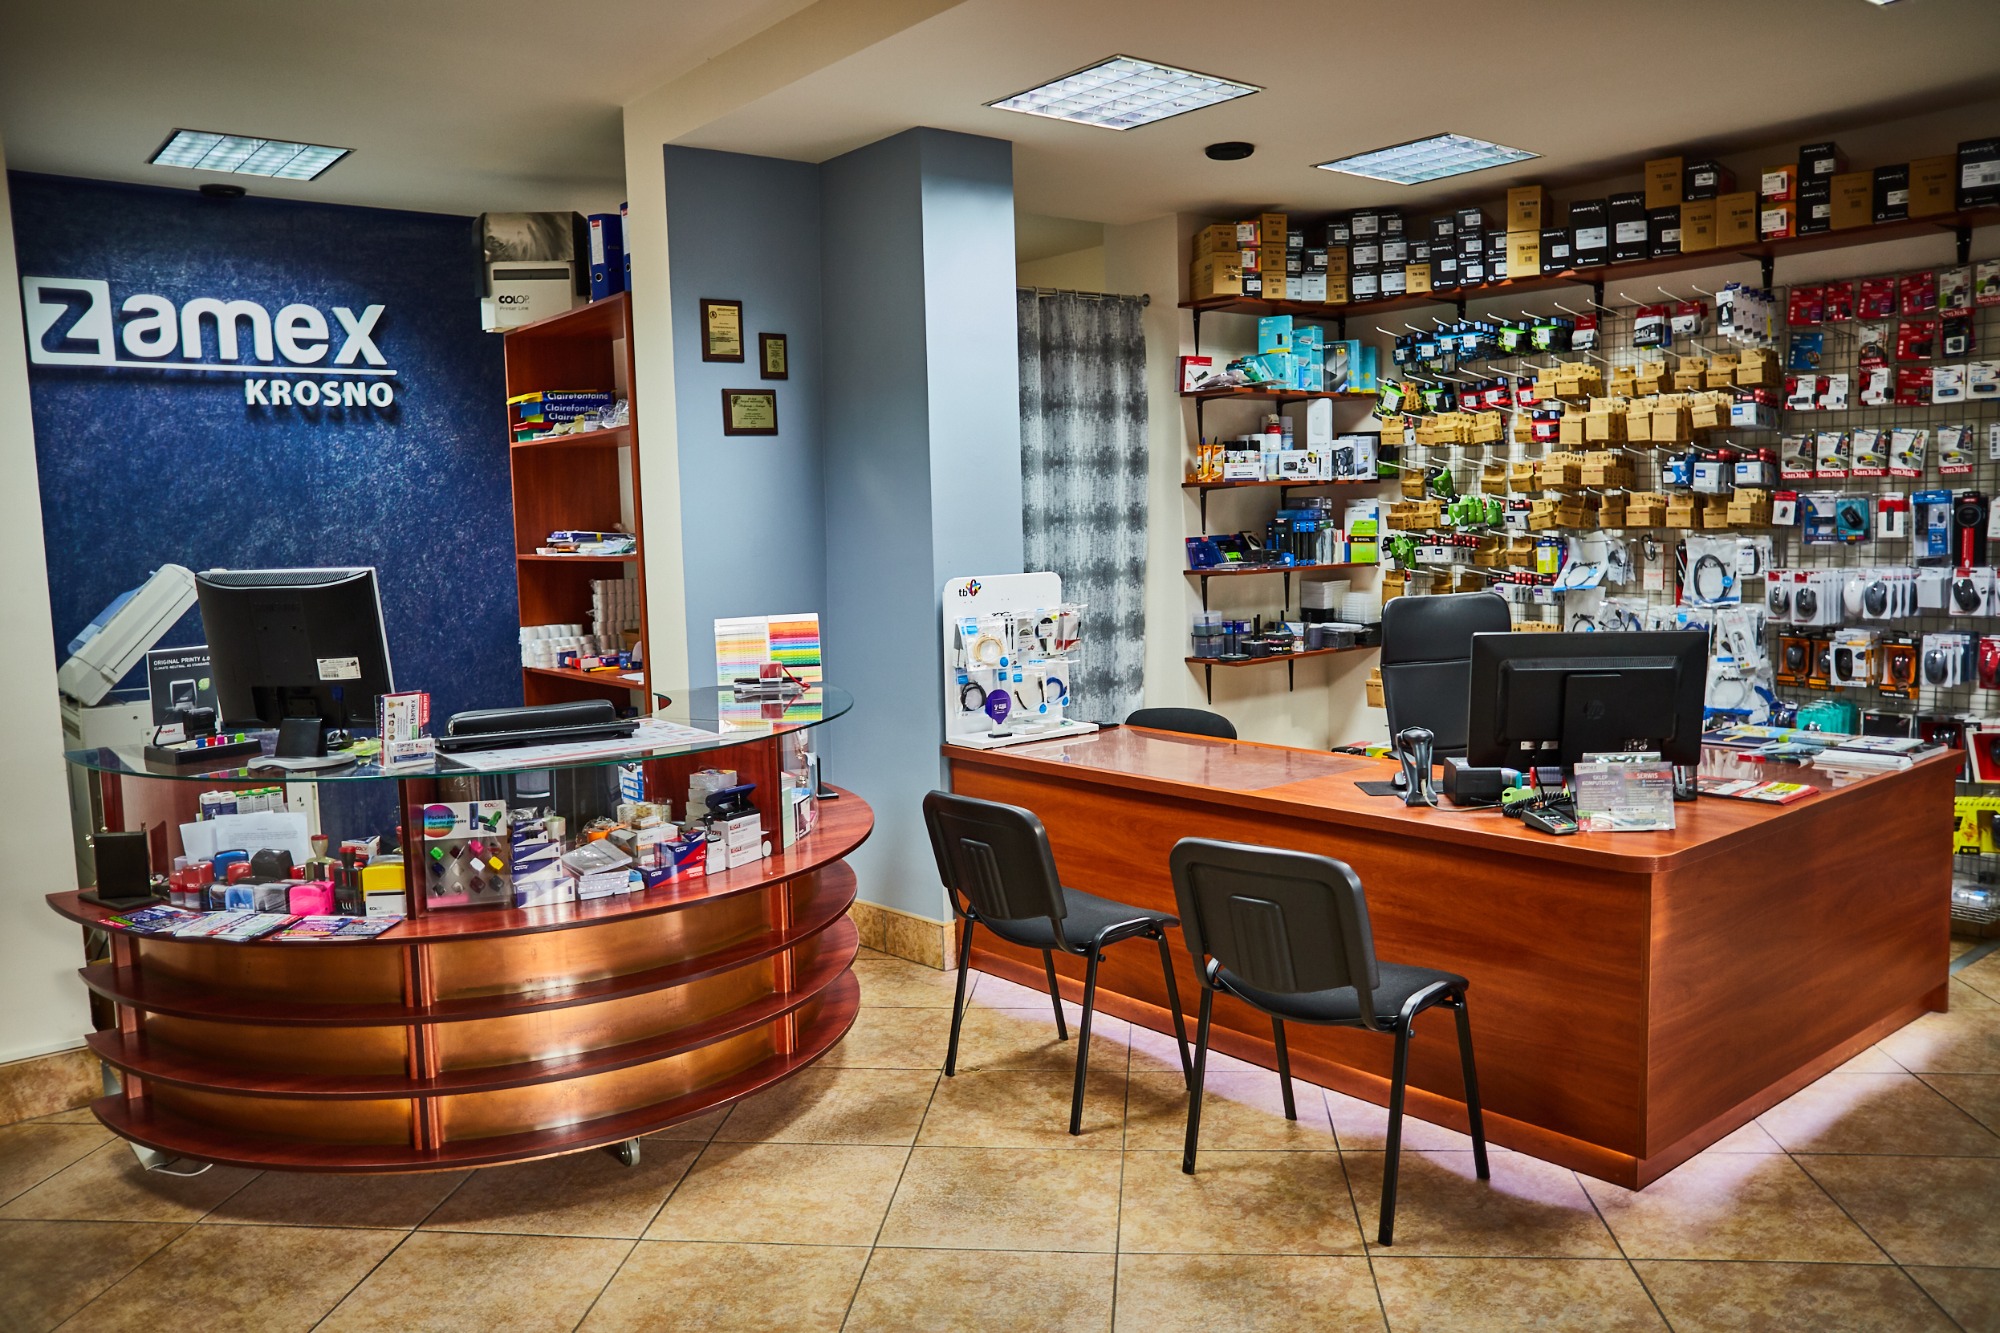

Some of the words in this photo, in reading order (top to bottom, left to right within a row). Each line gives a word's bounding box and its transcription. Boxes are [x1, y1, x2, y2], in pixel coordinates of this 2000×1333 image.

[498, 294, 530, 304] COLOP
[245, 379, 394, 408] KROSNO
[547, 392, 608, 400] Clairefontaine
[1817, 470, 1845, 478] SanDisk
[1853, 468, 1882, 476] SanDisk
[1889, 468, 1916, 477] SanDisk
[1940, 466, 1970, 474] SanDisk
[959, 589, 968, 597] tb
